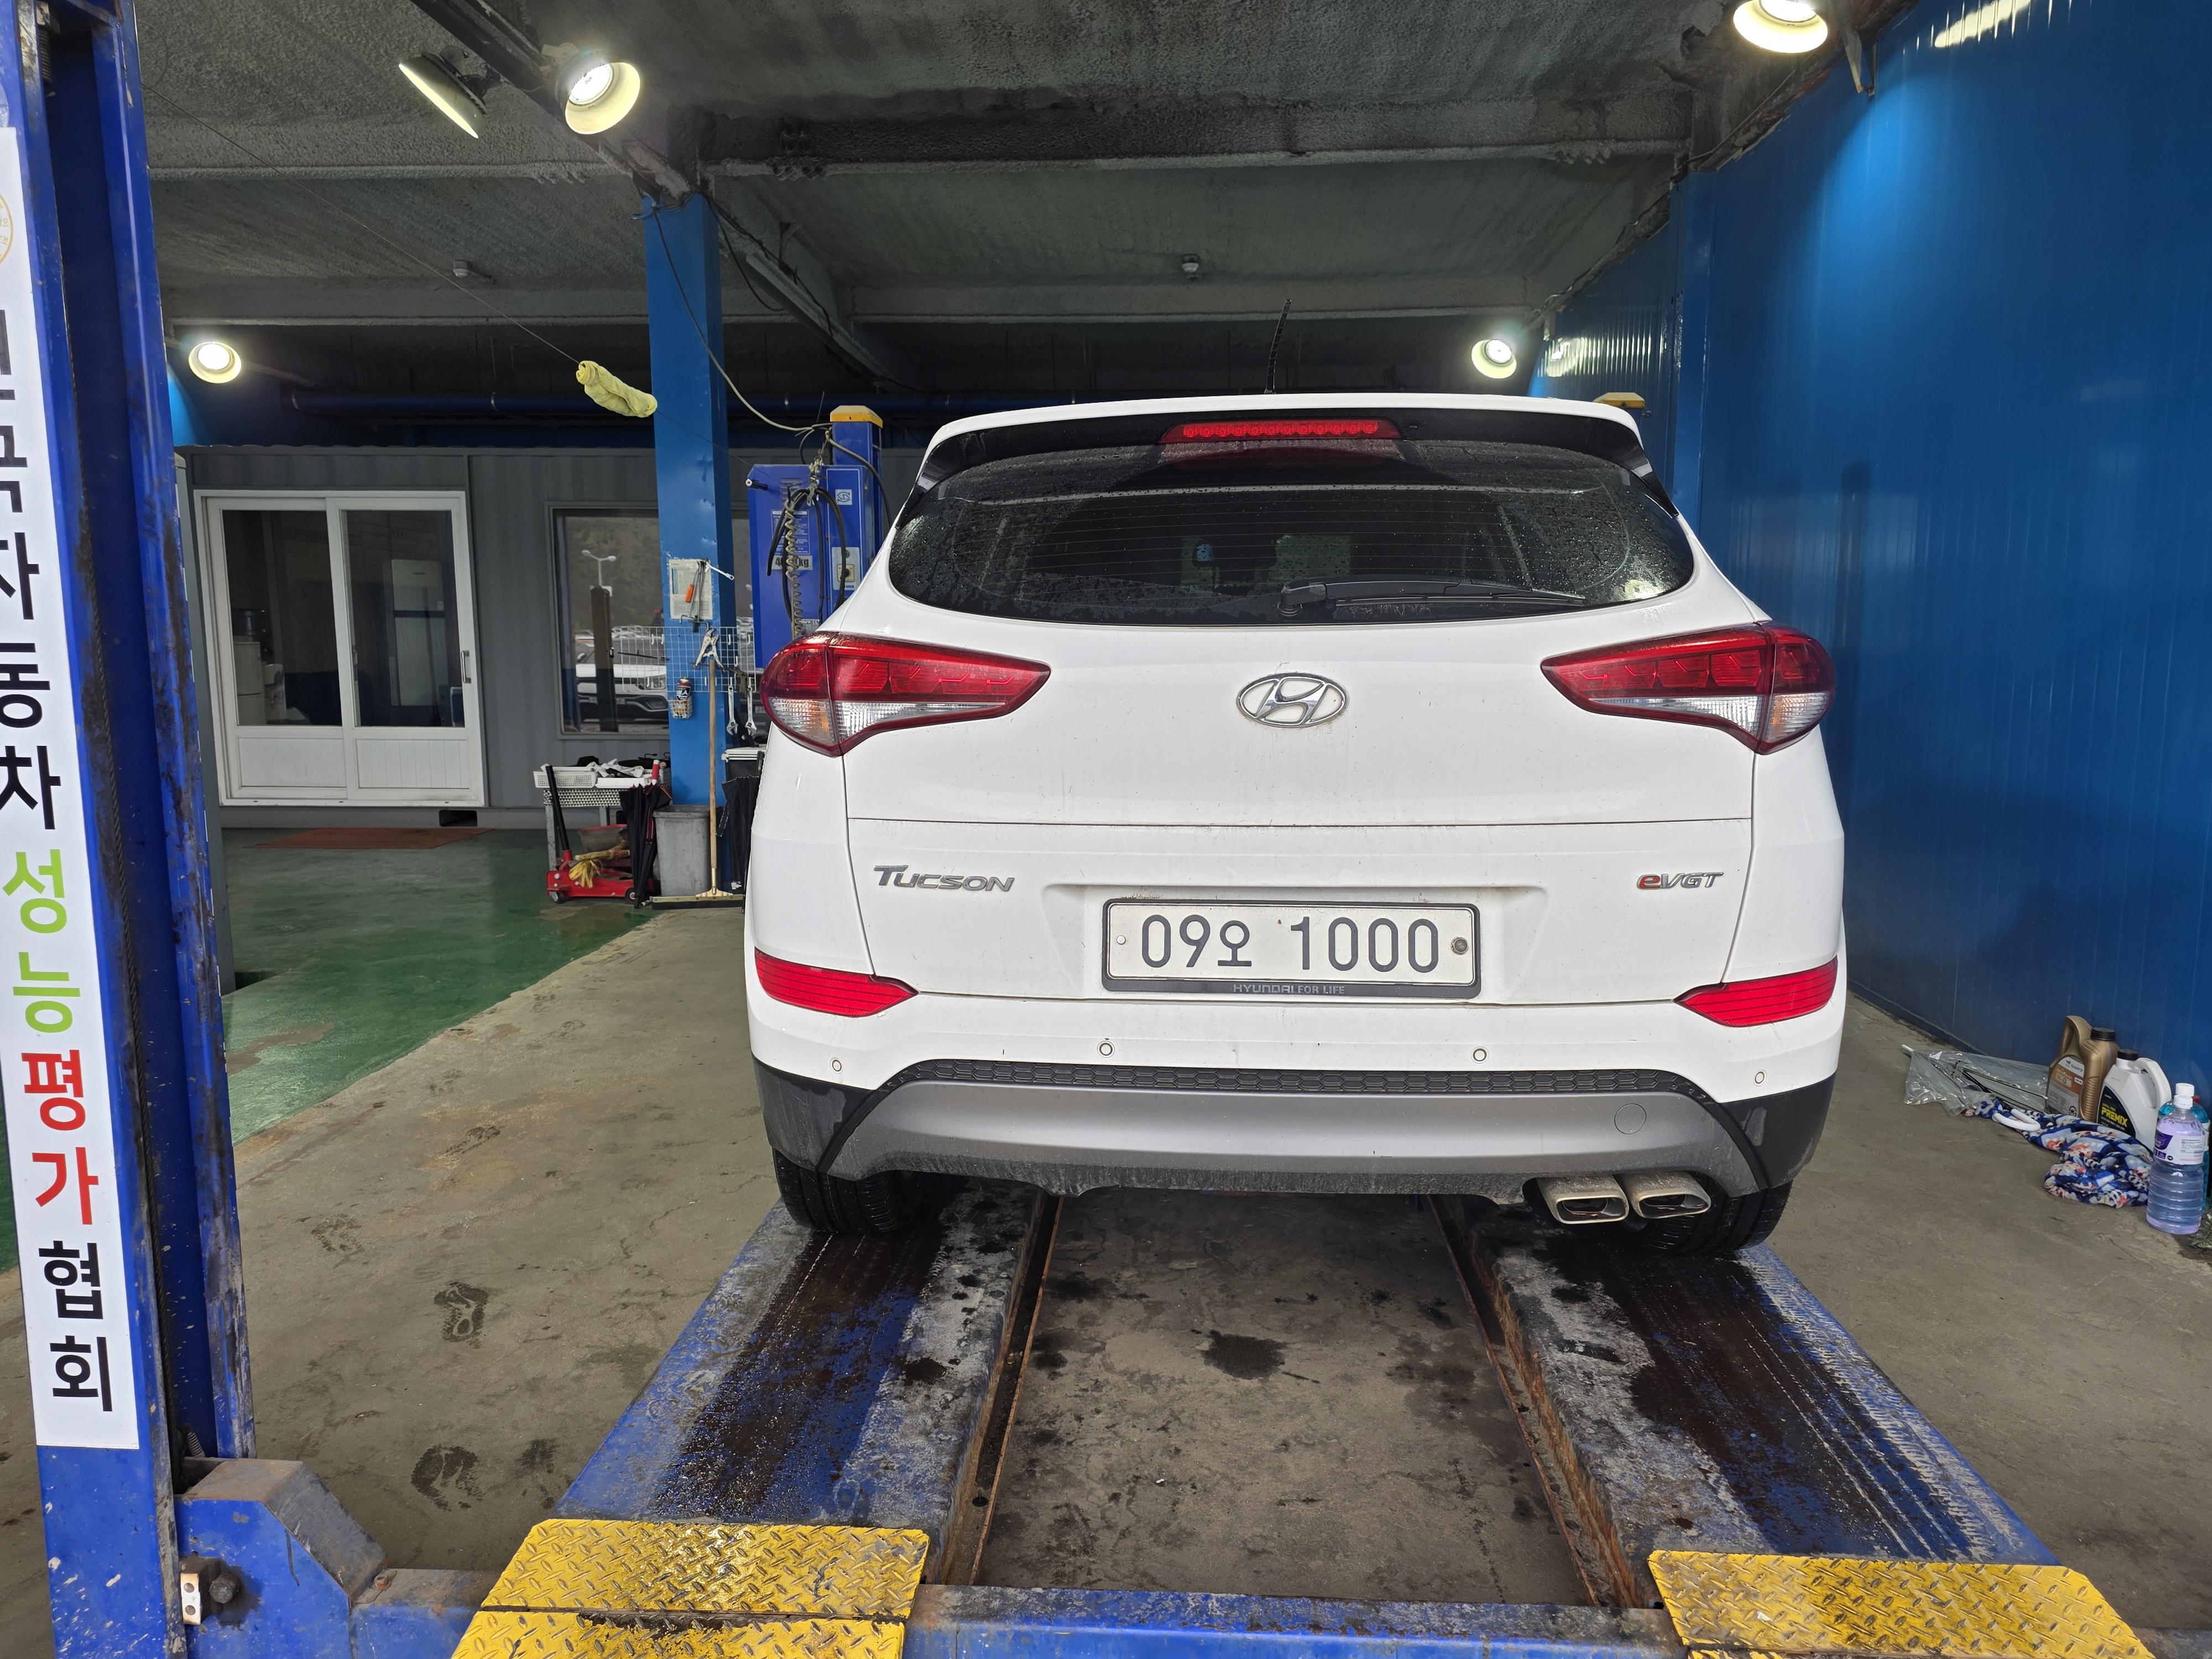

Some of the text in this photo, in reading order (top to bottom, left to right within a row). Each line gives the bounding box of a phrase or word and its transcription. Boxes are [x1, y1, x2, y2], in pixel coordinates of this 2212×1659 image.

[775, 557, 809, 568] 4kg
[873, 864, 1015, 892] TUCSON
[1636, 872, 1725, 890] eVGT
[1141, 914, 1439, 973] 09오 1000
[1233, 984, 1345, 994] HYUNDAI FOR LIFE
[2101, 1107, 2128, 1128] PREMIX
